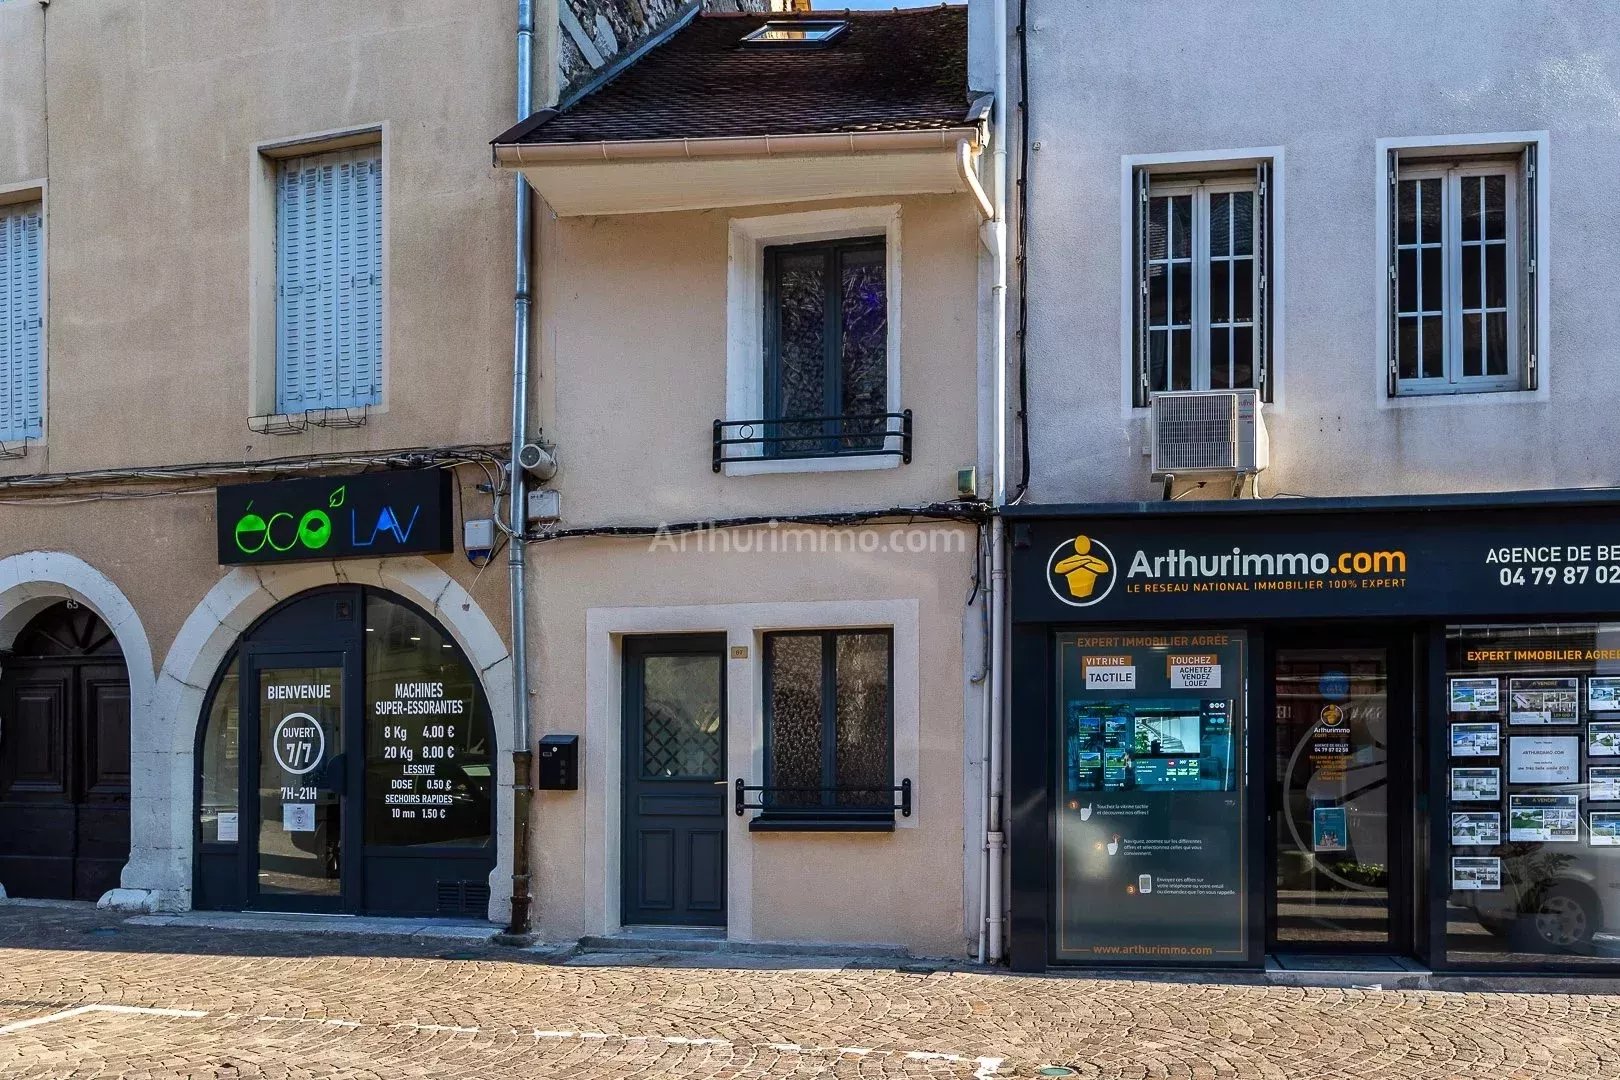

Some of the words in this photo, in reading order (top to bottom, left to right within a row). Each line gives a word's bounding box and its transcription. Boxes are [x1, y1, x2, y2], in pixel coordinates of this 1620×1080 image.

[352, 504, 420, 546] LAV
[1485, 547, 1561, 563] AGENCE
[1567, 546, 1591, 561] DE
[1126, 547, 1406, 578] Arthurimmo.com
[1500, 568, 1526, 586] 04
[1531, 567, 1557, 585] 79
[1563, 566, 1589, 585] 87
[1595, 565, 1620, 584] 02
[1127, 584, 1141, 593] LE
[1145, 583, 1189, 593] RESEAU
[1193, 582, 1250, 592] NATIONAL
[1254, 581, 1324, 591] IMMOBILIER
[1329, 580, 1358, 589] 100%
[1362, 578, 1406, 589] EXPERT
[66, 599, 79, 609] 65
[1077, 637, 1120, 647] EXPERT
[1122, 636, 1188, 647] IMMOBILIER
[1086, 657, 1125, 666] VITRINE
[1171, 656, 1211, 665] TOUCHEZ
[1467, 651, 1511, 661] EXPERT
[1514, 650, 1582, 660] IMMOBILIER
[1089, 672, 1133, 682] TACTILE
[267, 684, 331, 699] BIENVENUE
[395, 682, 443, 698] MACHINES
[375, 699, 463, 715] SUPER-ESSORANTES
[282, 727, 315, 738] OUVERT
[384, 726, 391, 738] 8
[393, 726, 407, 741] Kg
[422, 725, 444, 738] 4.00
[447, 725, 455, 738] €
[286, 741, 311, 766] 7/7
[384, 746, 397, 759] 20
[400, 746, 413, 761] Kg
[422, 746, 444, 758] 8.00
[447, 745, 455, 758] €
[403, 764, 435, 774] LESSIVE
[391, 780, 413, 789] DOSE
[426, 780, 444, 789] 0.50
[446, 780, 452, 790] €
[280, 786, 317, 800] 7H-21H
[385, 794, 420, 803] SECHOIRS
[421, 794, 453, 803] RAPIDES
[391, 808, 400, 818] 10
[402, 810, 416, 818] mn
[422, 808, 438, 818] 1.50
[440, 808, 446, 818] €
[1093, 944, 1213, 956] www.arthurimmo.com
